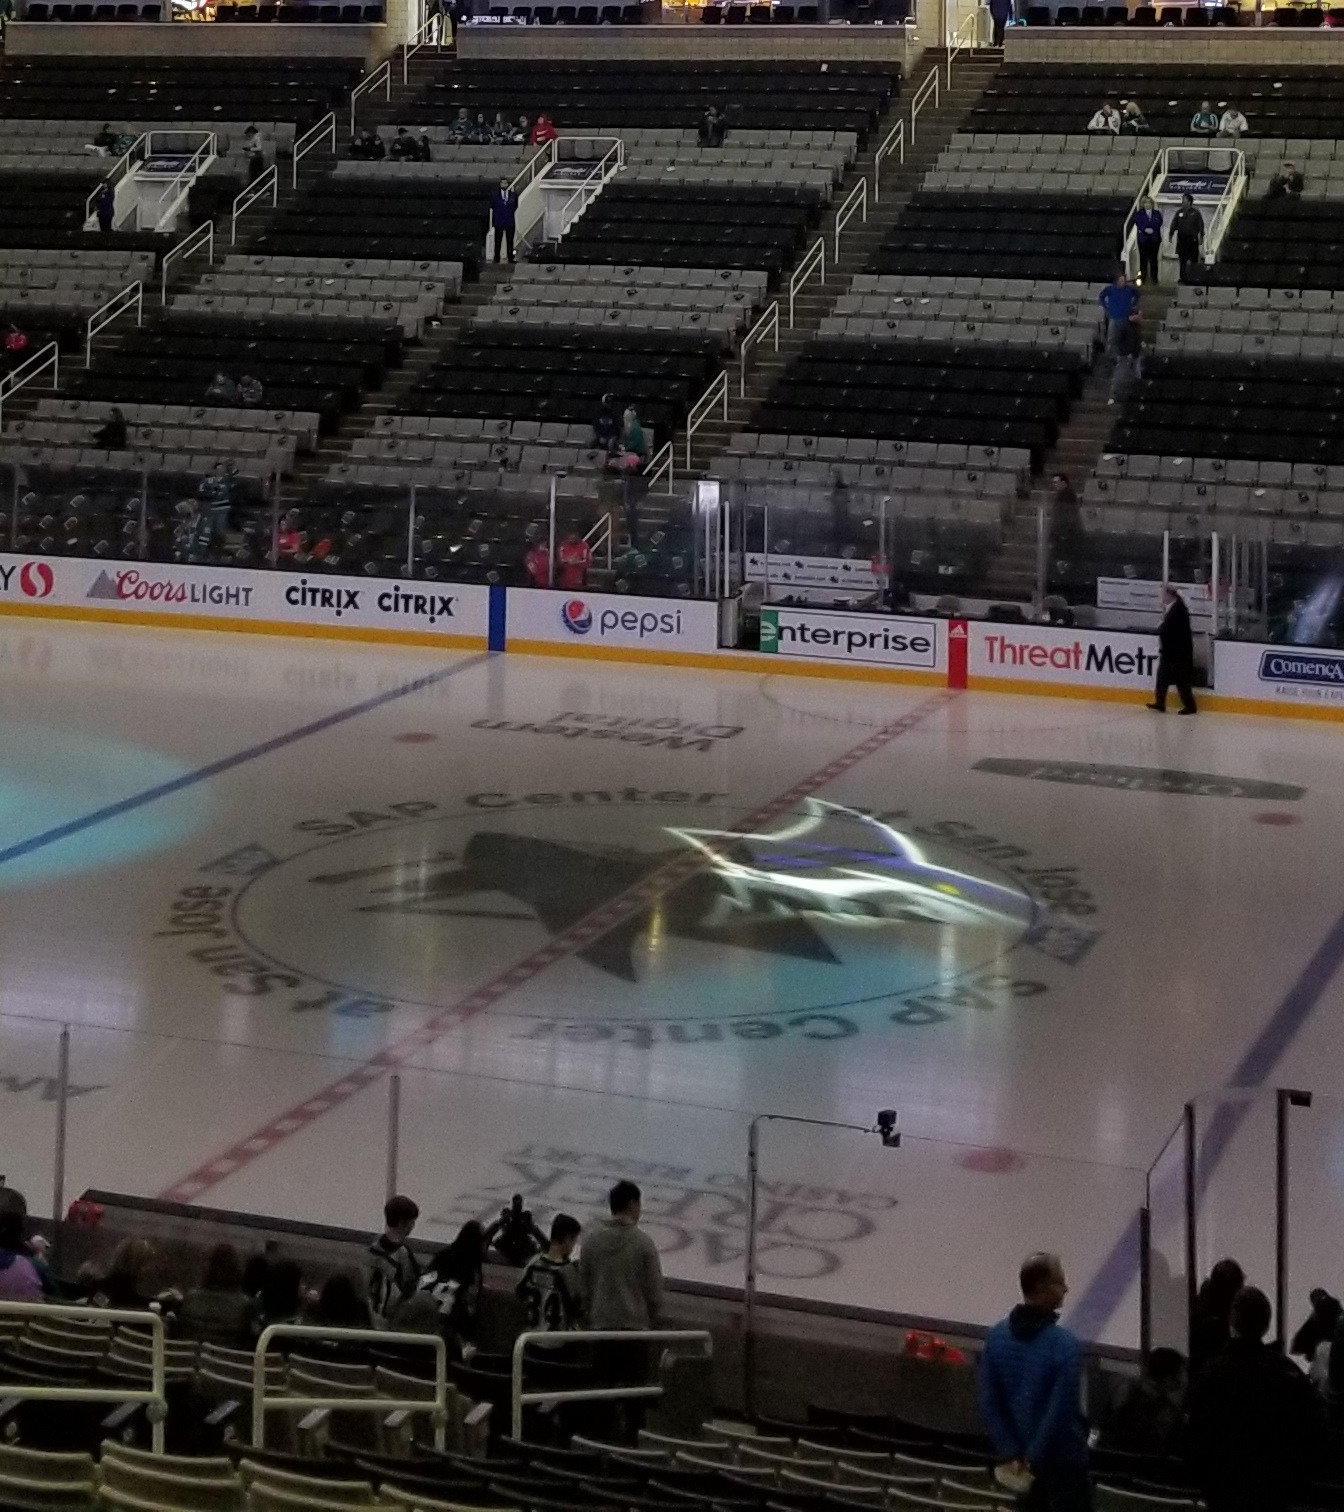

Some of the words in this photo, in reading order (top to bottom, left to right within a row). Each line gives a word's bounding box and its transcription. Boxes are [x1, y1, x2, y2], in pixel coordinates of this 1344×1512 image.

[115, 569, 189, 603] Coors
[190, 582, 254, 607] LIGHT
[599, 607, 682, 638] pepsi
[759, 621, 932, 655] enterprise
[983, 635, 1160, 679] ThreatMetr
[293, 799, 438, 837] SAP
[465, 788, 730, 810] Center
